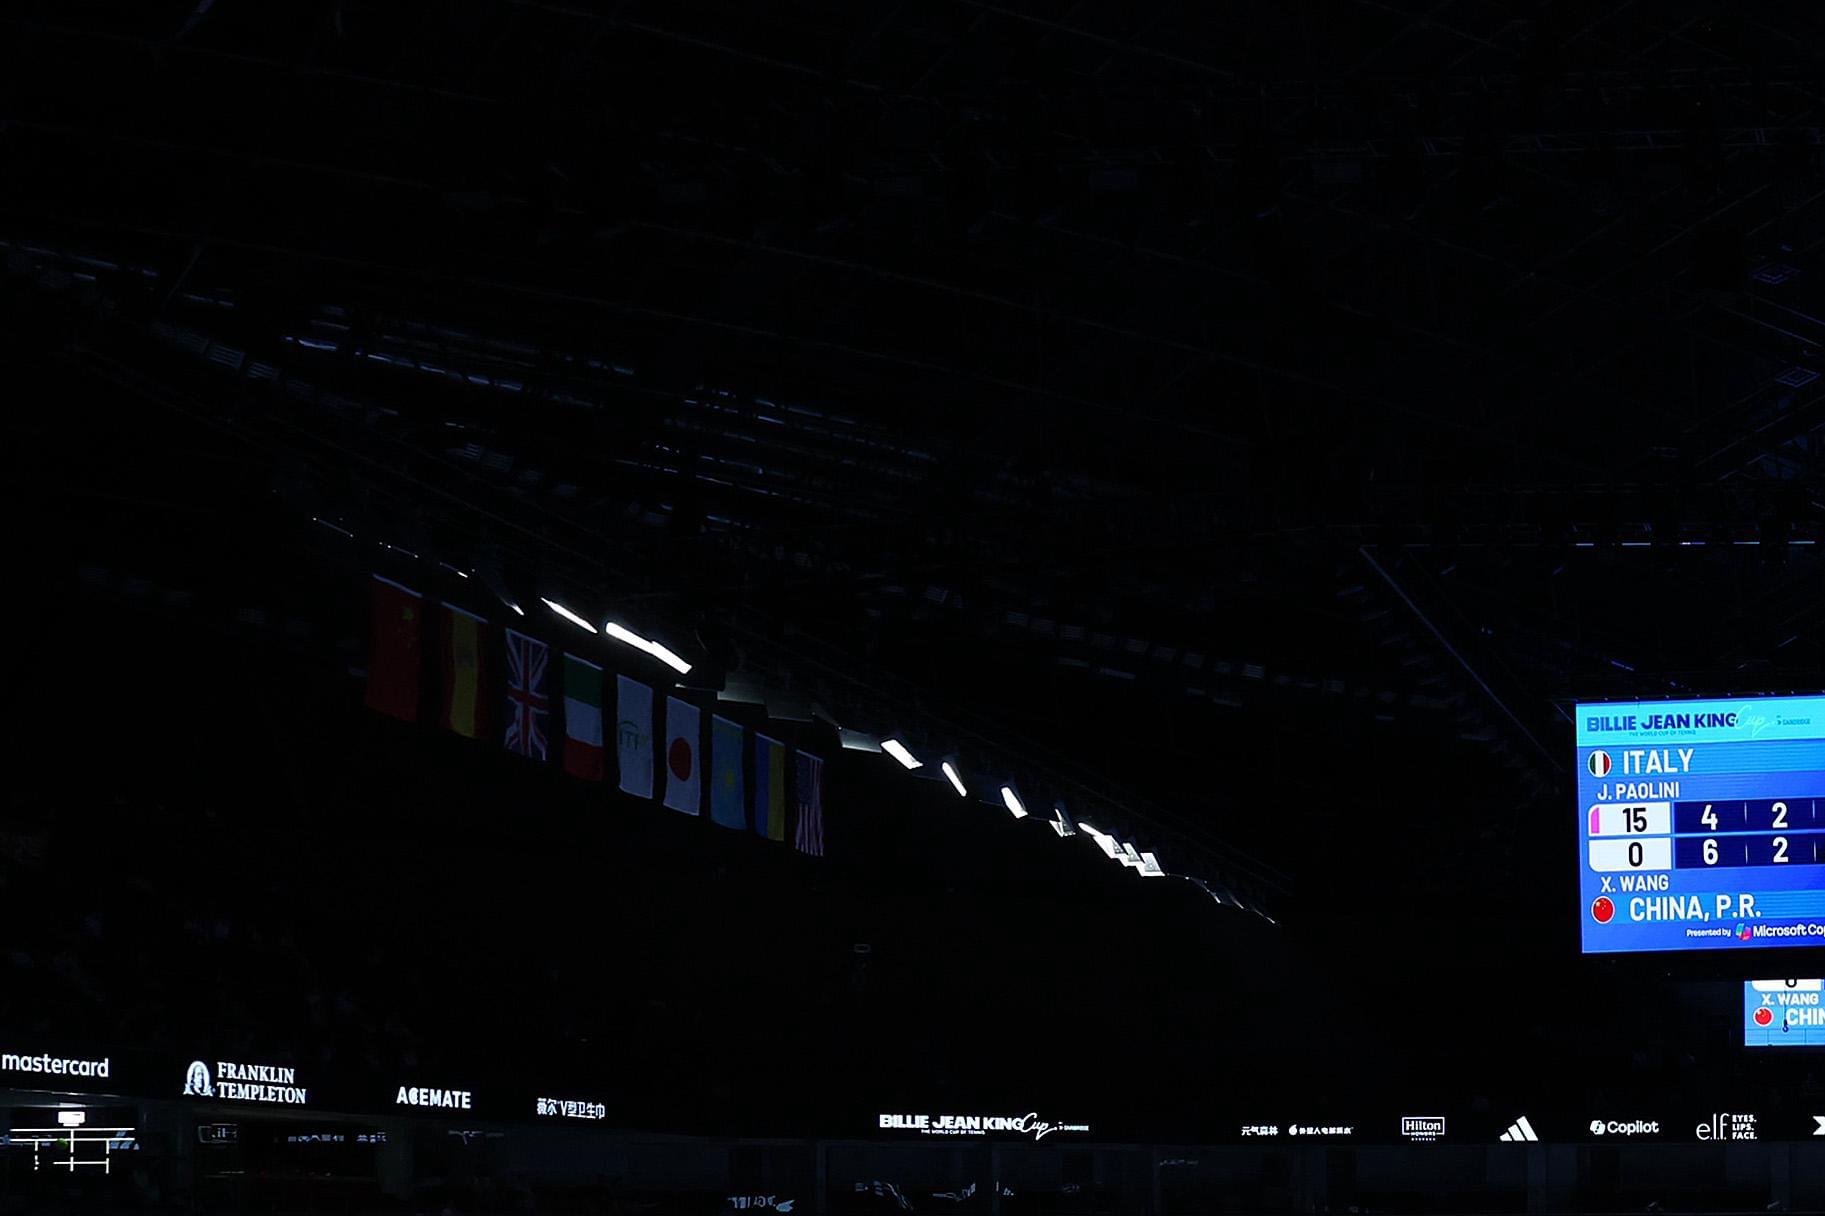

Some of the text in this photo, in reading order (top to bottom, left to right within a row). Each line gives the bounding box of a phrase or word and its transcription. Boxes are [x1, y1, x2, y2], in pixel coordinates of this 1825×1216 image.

[1587, 715, 1637, 732] BILLIE
[1641, 714, 1691, 730] JEAN
[1694, 713, 1738, 729] KING
[1622, 748, 1694, 775] ITALY
[1597, 781, 1680, 800] J. PAOLINI
[1622, 802, 1788, 833] 15 4 2
[1628, 837, 1788, 867] 0 6 2
[1600, 874, 1669, 892] X. WANG
[1629, 894, 1761, 922] CHINA, P.R.
[1686, 927, 1721, 937] Presented
[1722, 928, 1731, 938] by
[1753, 923, 1807, 938] Microsoft
[1762, 993, 1819, 1005] X. WANG
[2, 1054, 109, 1077] mastercard
[217, 1062, 295, 1084] FRANKLIN
[217, 1082, 307, 1104] TEMPLETON
[396, 1086, 471, 1109] ACEMATE
[879, 1114, 929, 1128] BILLIE
[932, 1116, 980, 1130] JEAN
[983, 1117, 1024, 1131] KING
[1405, 1120, 1441, 1131] Hilton
[1607, 1120, 1659, 1136] Copilot
[1732, 1123, 1754, 1131] LIPS.
